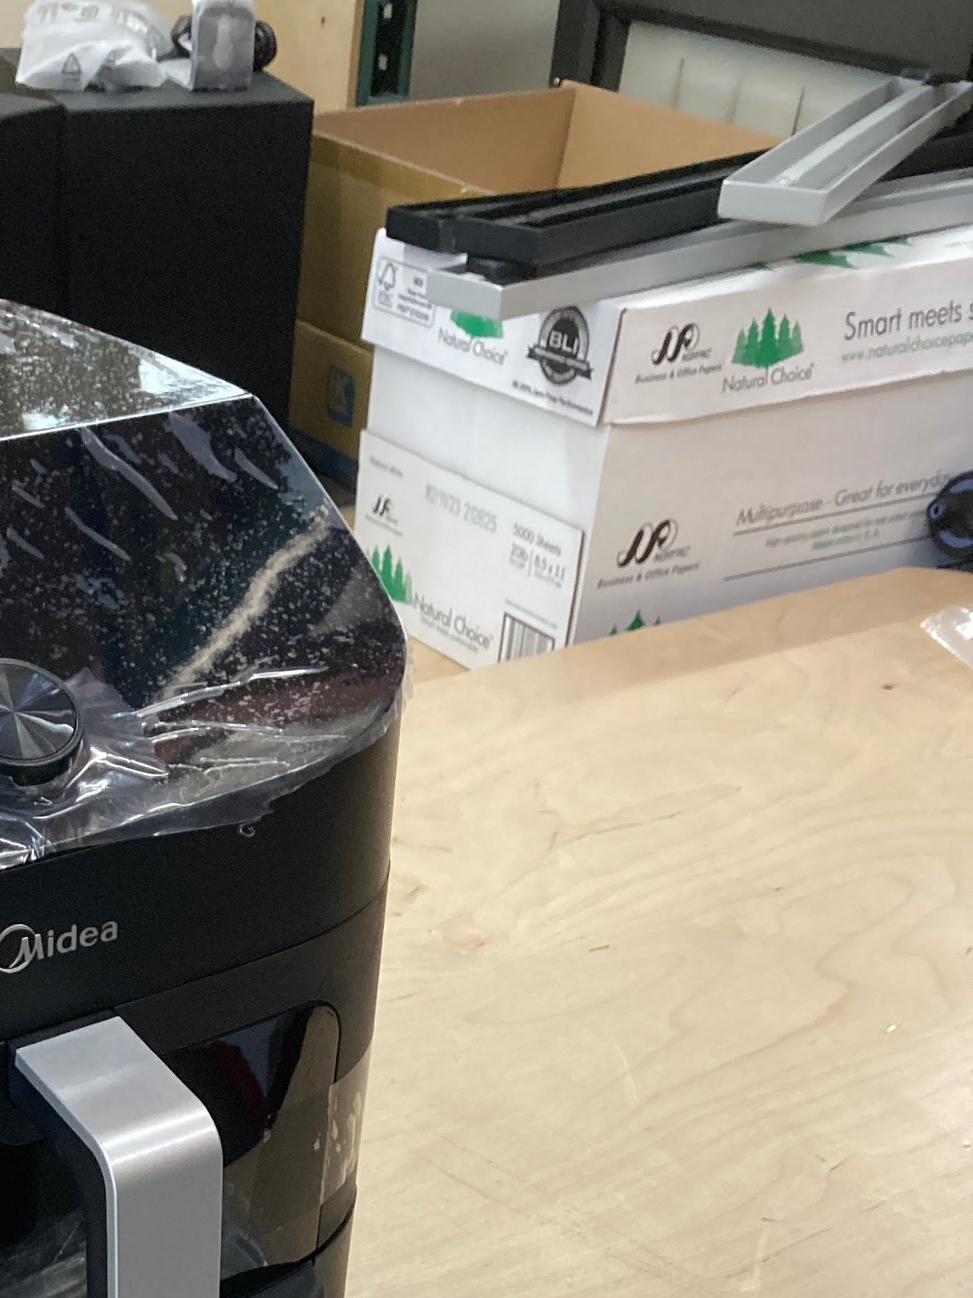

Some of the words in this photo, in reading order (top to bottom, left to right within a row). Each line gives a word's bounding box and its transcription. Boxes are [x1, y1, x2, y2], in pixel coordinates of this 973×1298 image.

[845, 308, 902, 341] Smart
[908, 299, 962, 330] meets
[438, 327, 473, 353] Natural
[549, 331, 578, 354] BLI
[722, 369, 768, 393] Natural
[771, 364, 812, 386] Choice
[736, 499, 823, 526] Multipurpose
[835, 488, 873, 506] Great
[876, 480, 894, 499] for
[413, 591, 453, 627] Natural
[454, 615, 490, 650] Choice
